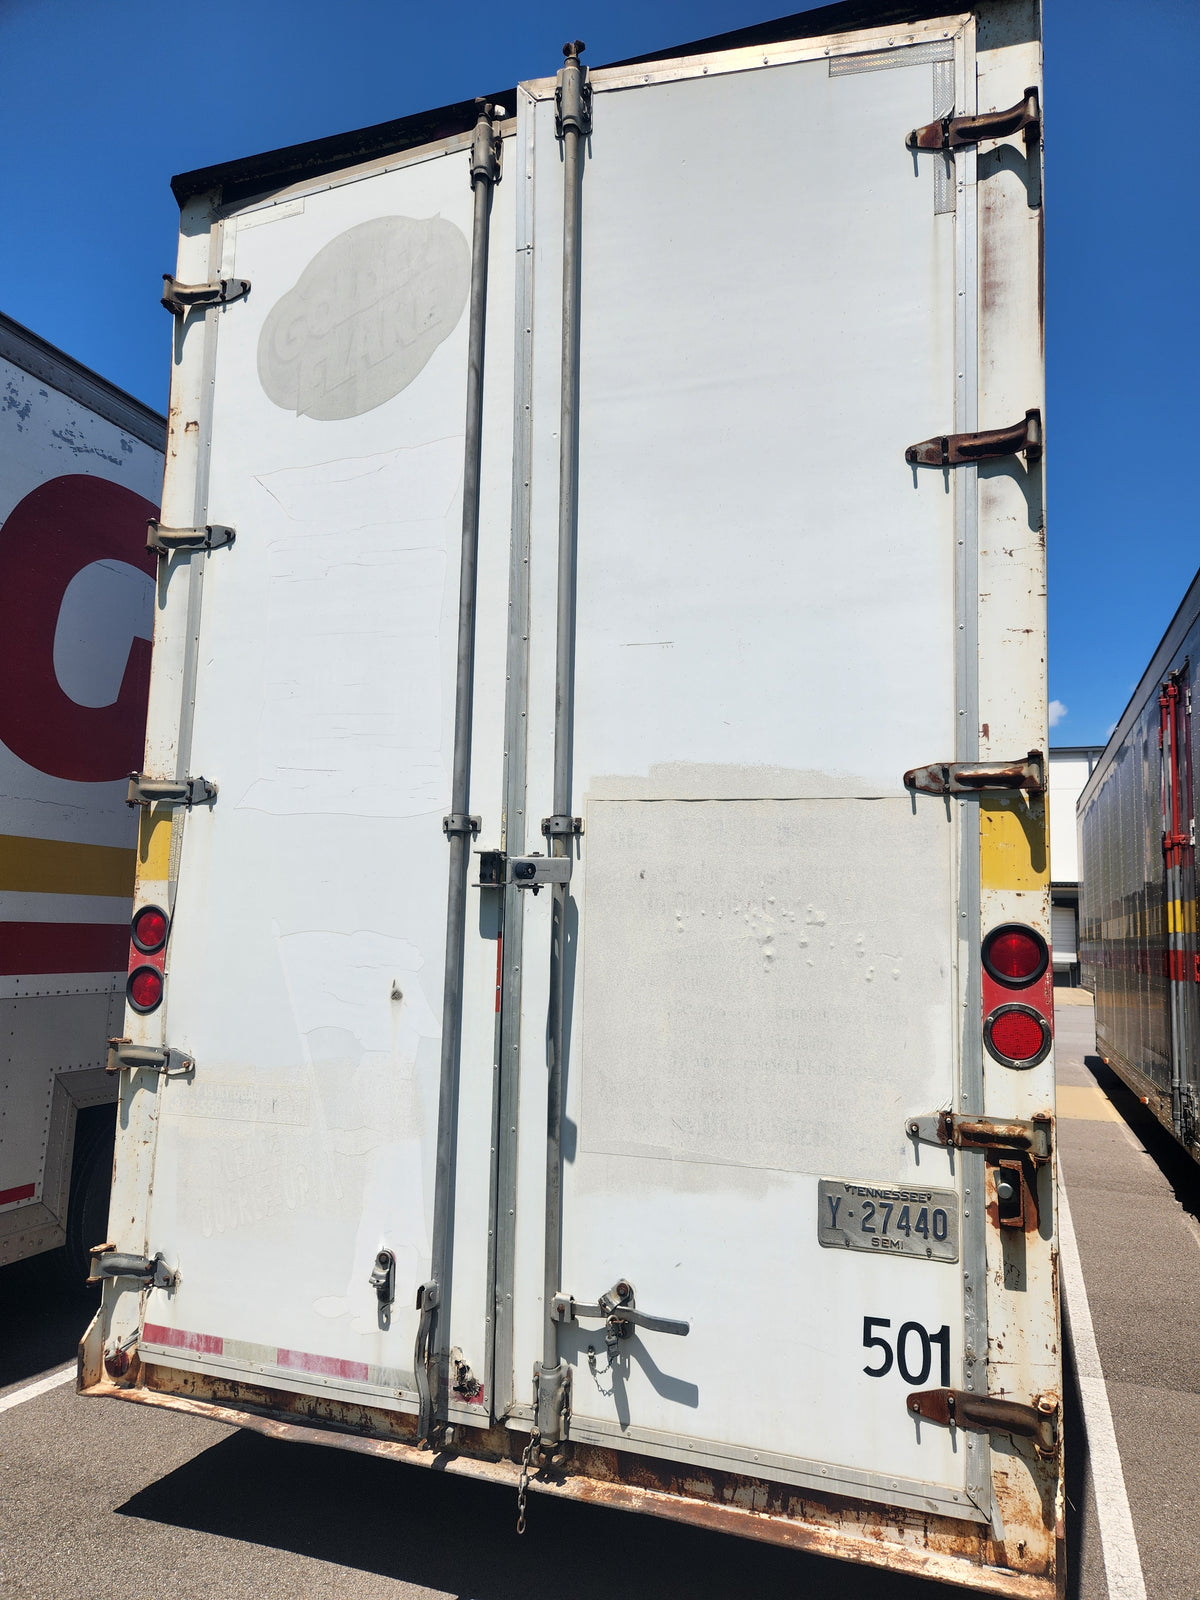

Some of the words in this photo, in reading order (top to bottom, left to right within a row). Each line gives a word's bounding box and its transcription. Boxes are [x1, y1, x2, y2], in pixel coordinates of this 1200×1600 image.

[848, 1184, 928, 1203] TENNESSEE
[871, 1237, 904, 1250] SEMI
[862, 1315, 951, 1388] 501
